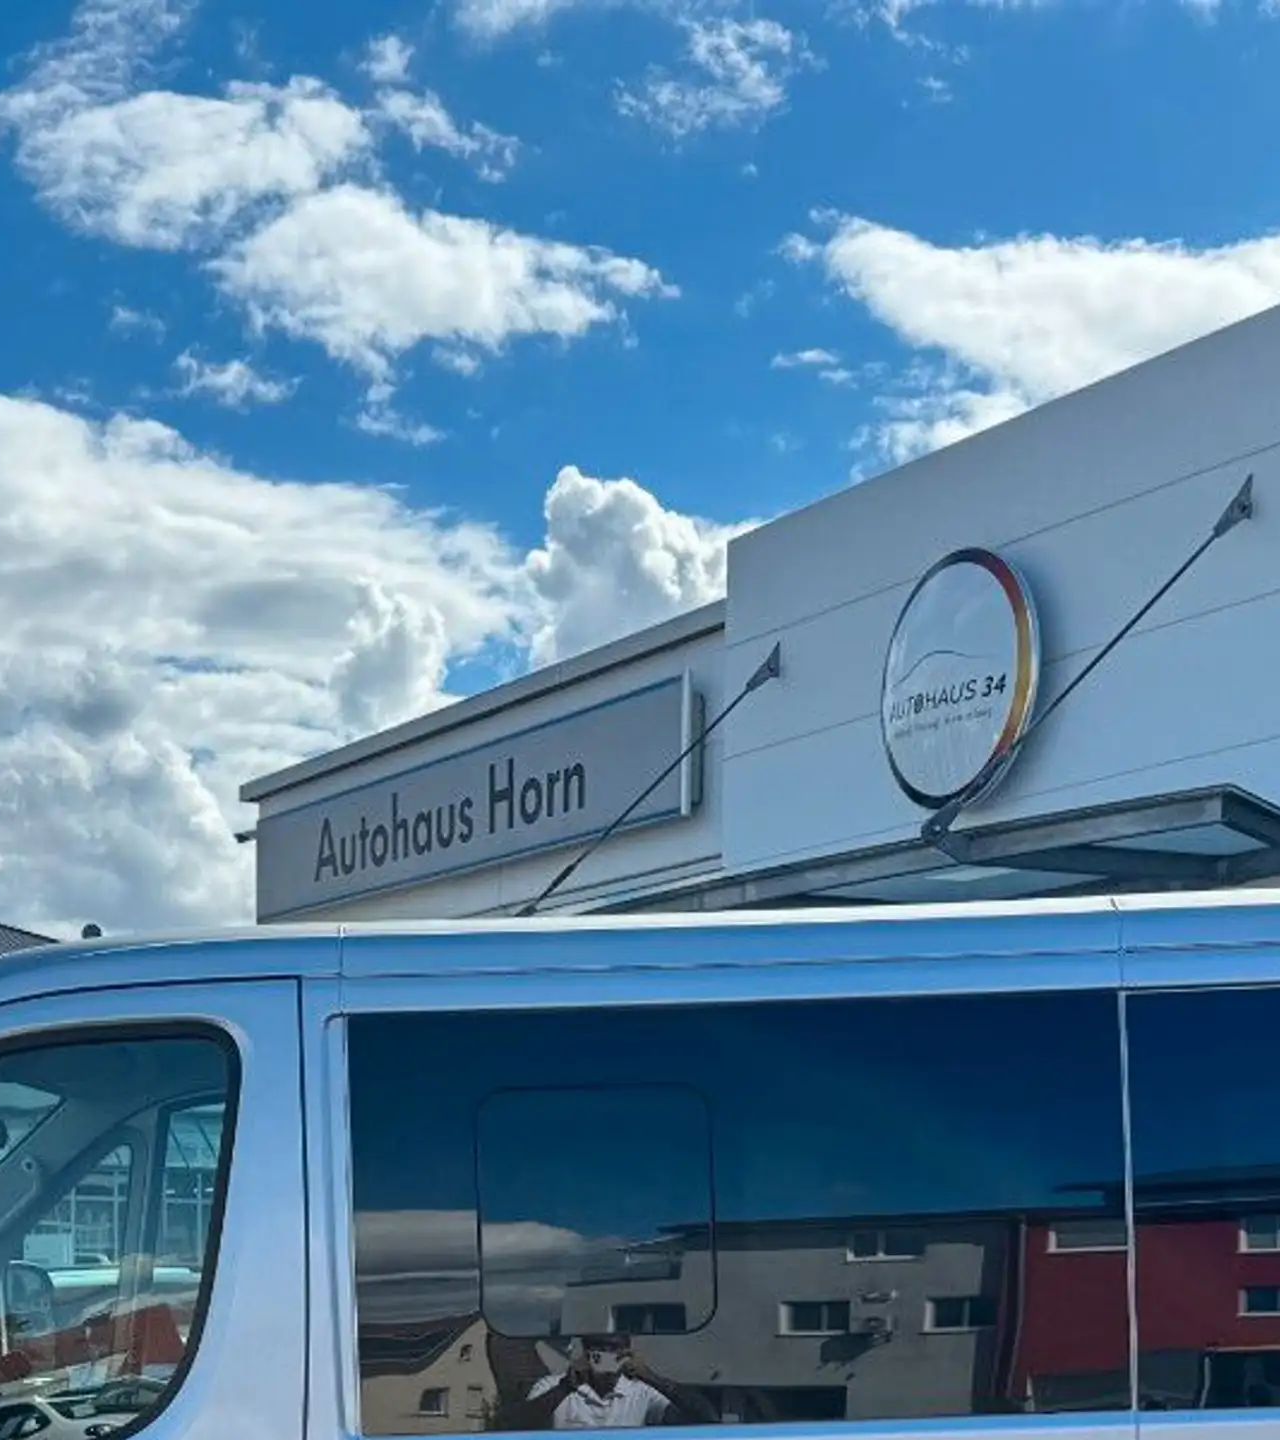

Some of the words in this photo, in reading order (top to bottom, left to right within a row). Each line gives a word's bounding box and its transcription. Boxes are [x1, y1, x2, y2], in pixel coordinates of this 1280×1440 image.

[981, 673, 1006, 697] 34
[315, 793, 474, 882] Autohaus
[488, 758, 585, 835] Horn
